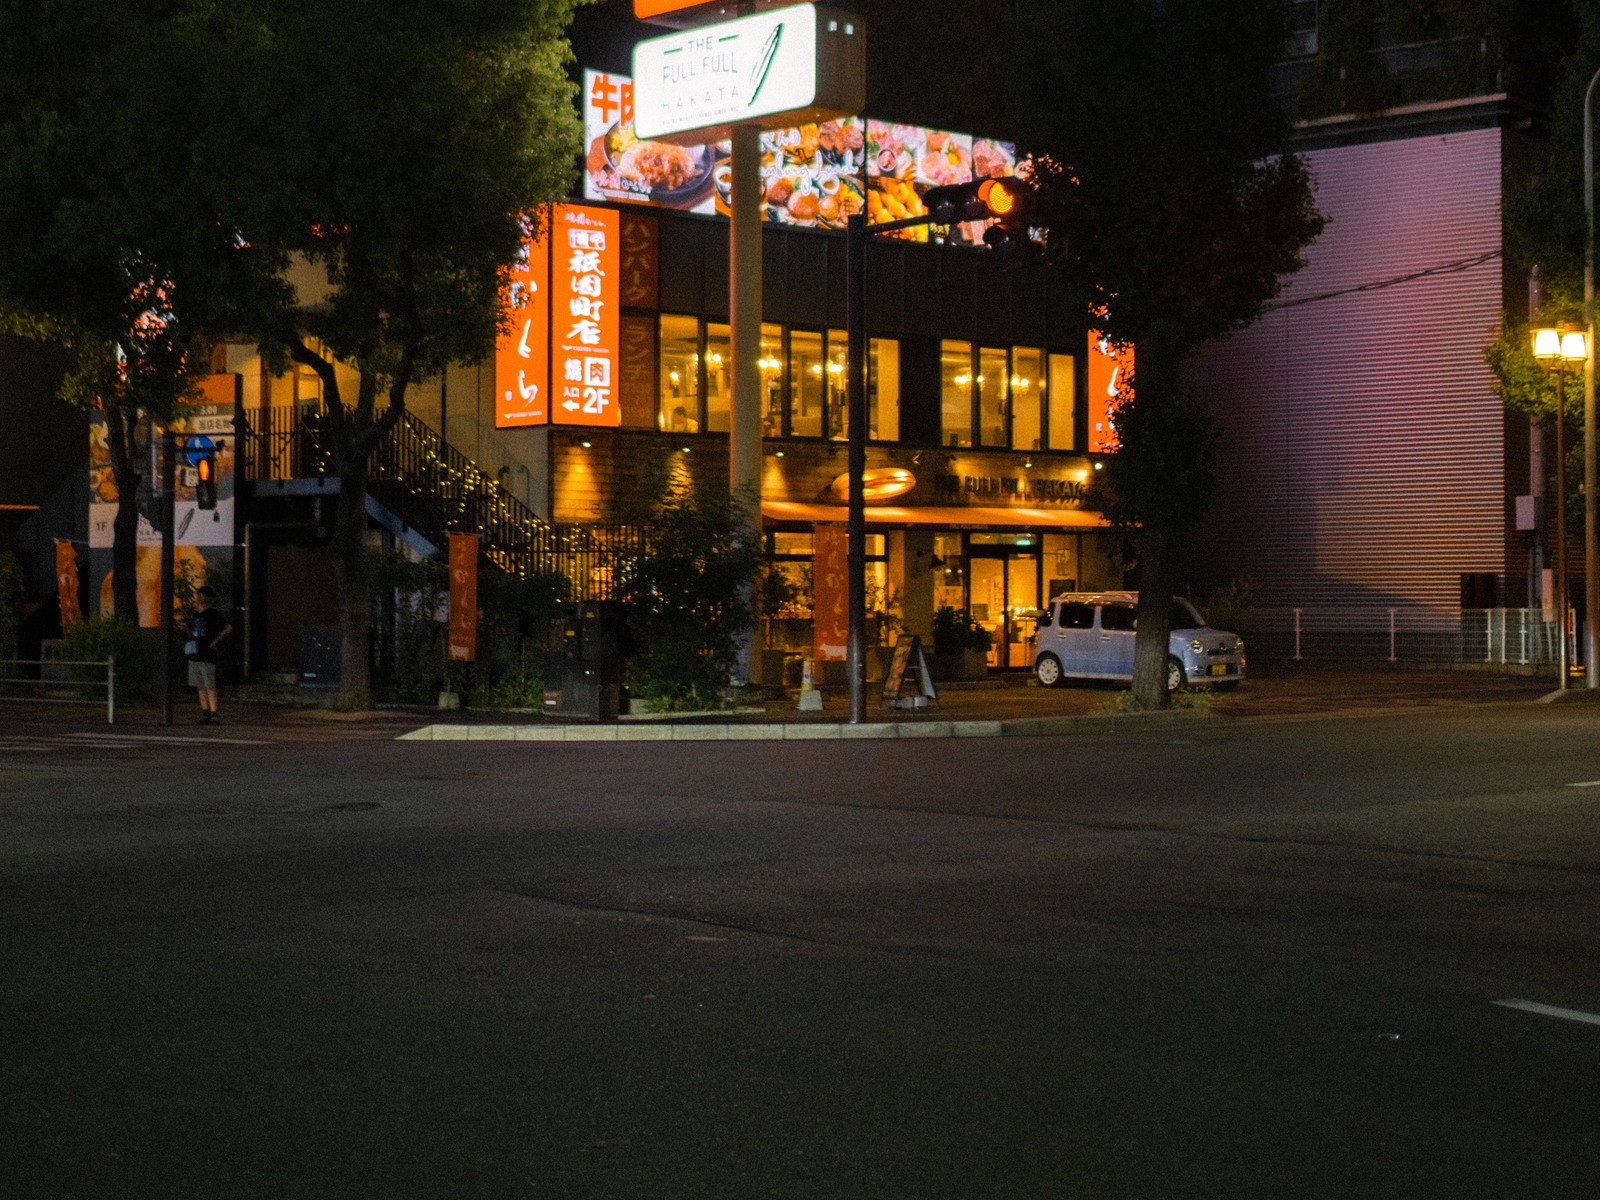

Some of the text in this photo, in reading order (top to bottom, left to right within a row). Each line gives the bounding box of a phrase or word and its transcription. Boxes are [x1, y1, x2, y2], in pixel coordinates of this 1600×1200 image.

[687, 36, 713, 52] THE
[663, 52, 738, 84] FULL FULL
[662, 85, 739, 111] HAKATA
[563, 386, 579, 398] 入口
[583, 387, 610, 414] 2F
[96, 521, 108, 532] 1F
